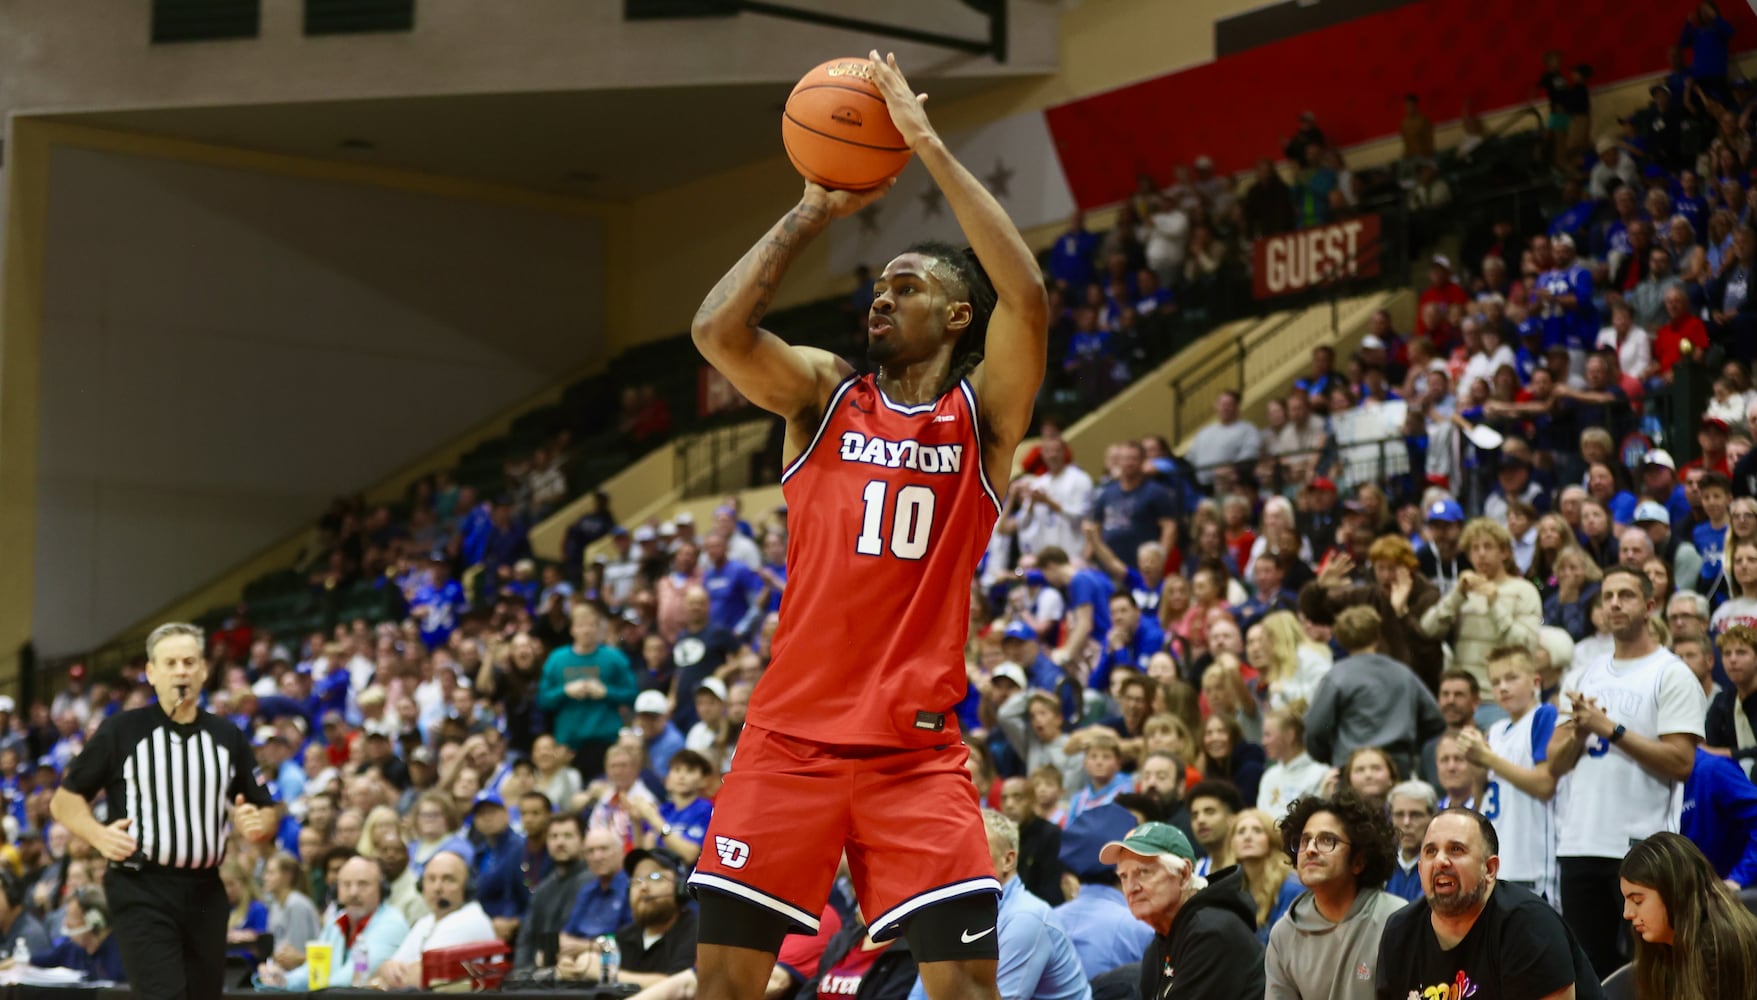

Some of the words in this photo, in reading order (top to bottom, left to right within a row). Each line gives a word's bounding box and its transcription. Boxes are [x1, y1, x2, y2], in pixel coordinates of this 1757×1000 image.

[1266, 221, 1363, 292] GUEST
[840, 431, 963, 473] DAYTON
[856, 480, 936, 560] 10
